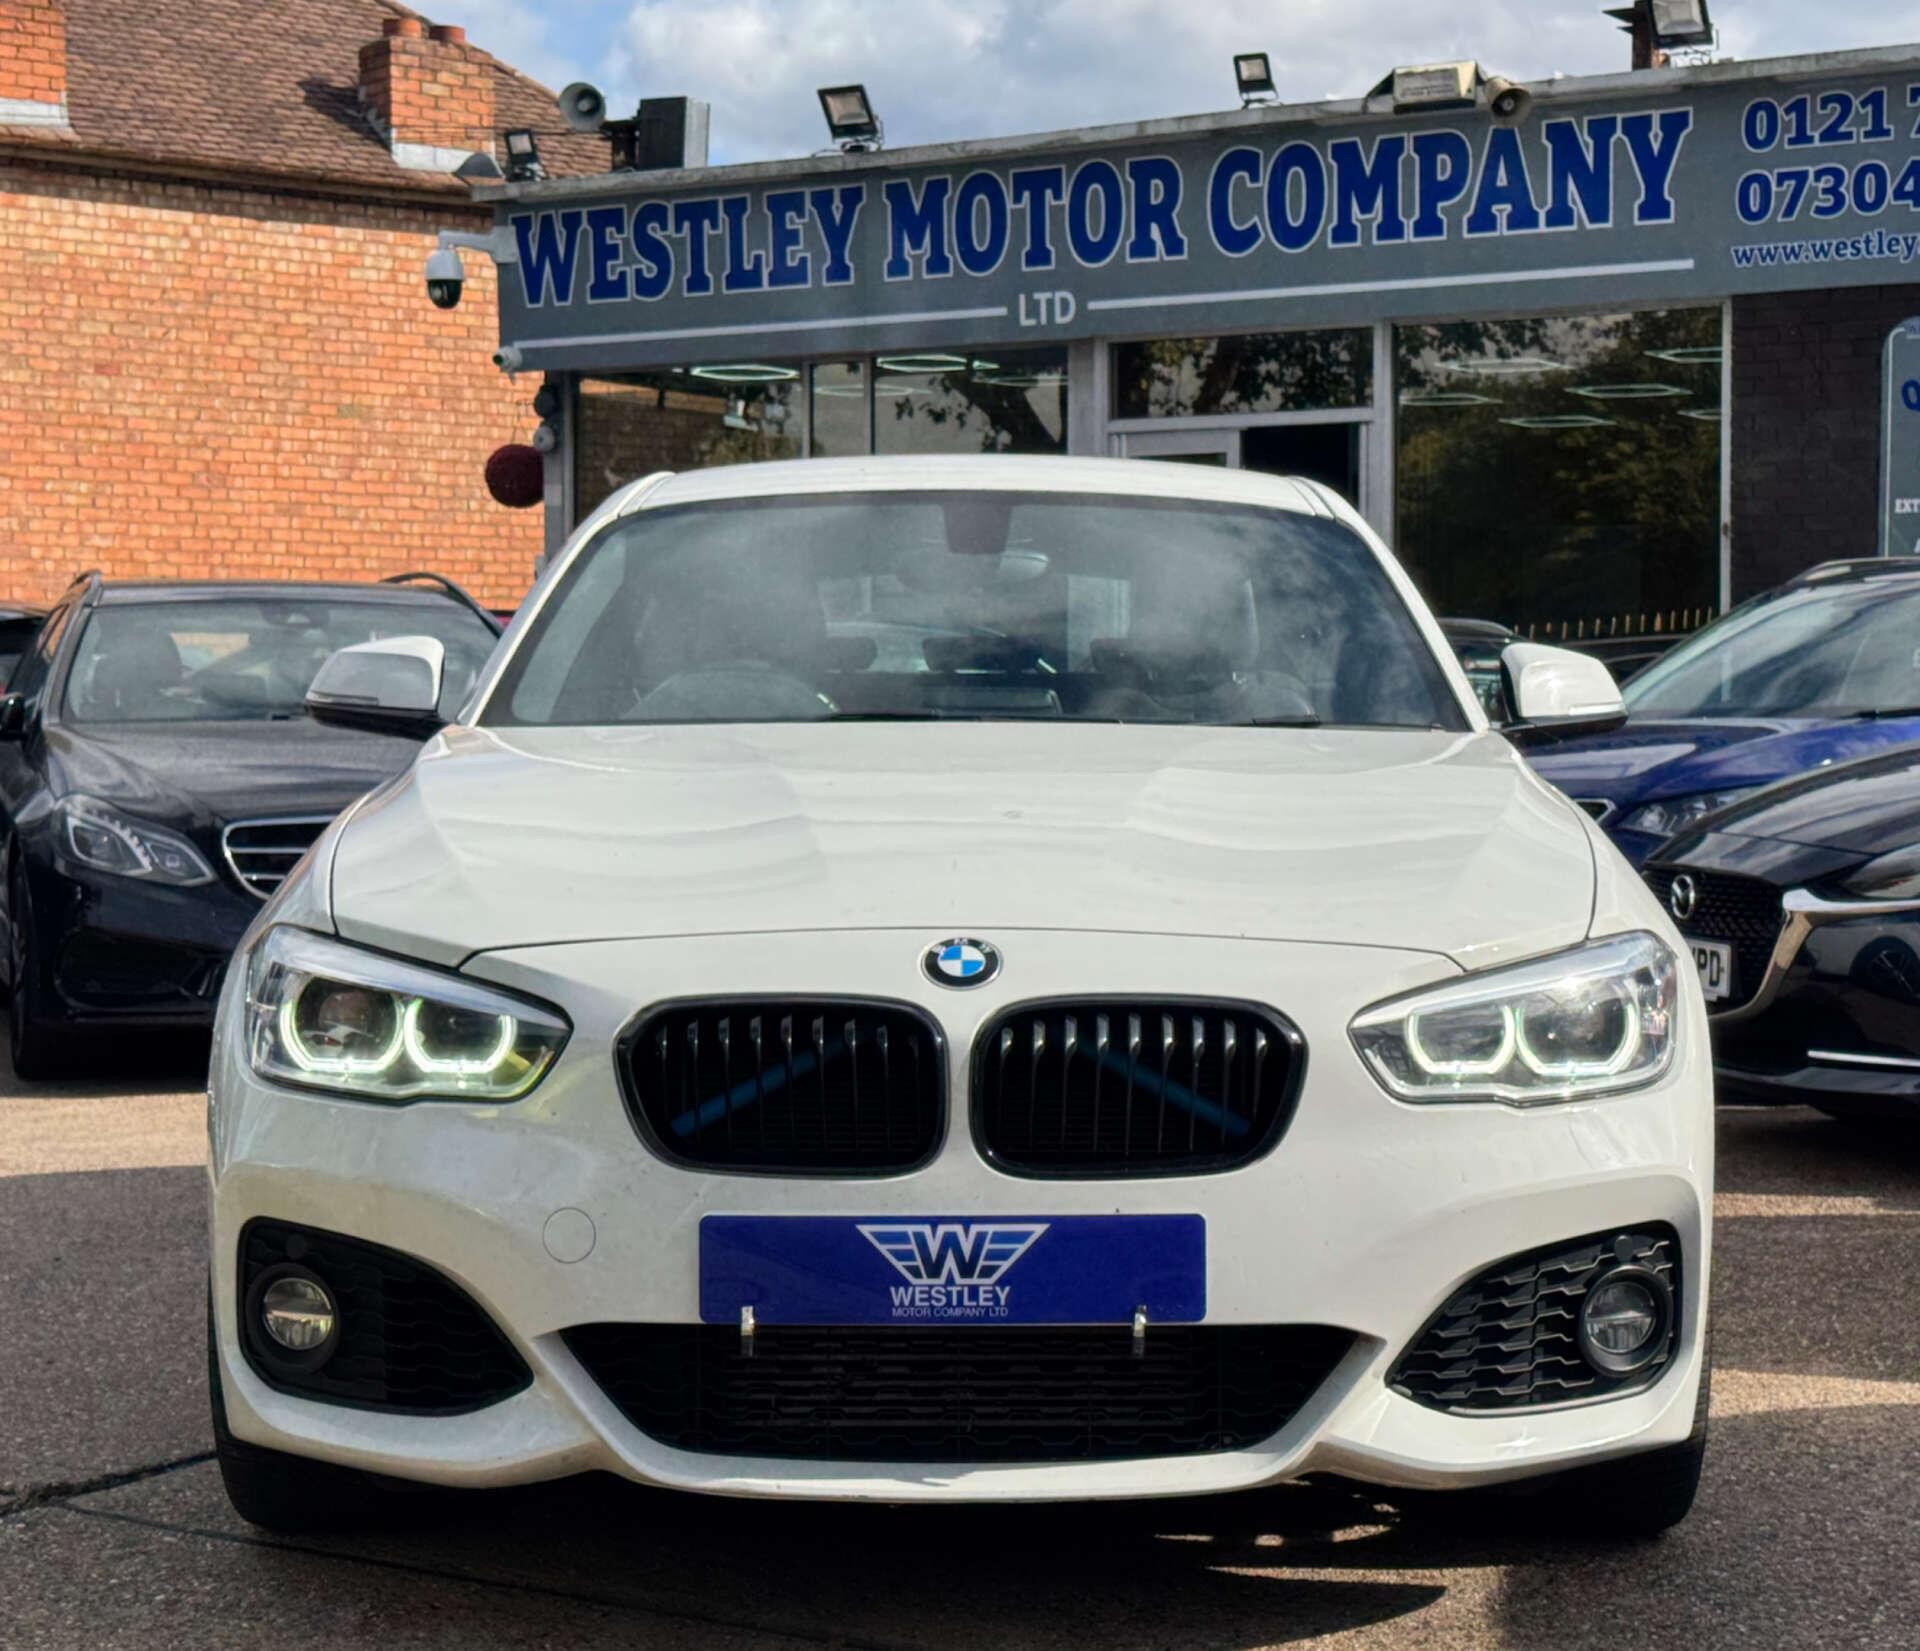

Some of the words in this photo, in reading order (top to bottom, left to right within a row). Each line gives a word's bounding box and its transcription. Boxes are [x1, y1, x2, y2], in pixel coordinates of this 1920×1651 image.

[1741, 87, 1895, 153] 0121
[511, 182, 866, 308] WESTLEY
[883, 156, 1188, 283] MOTOR
[1207, 106, 1693, 258] COMPANY
[1735, 157, 1920, 225] 07304
[1731, 228, 1920, 268] www.westley
[1019, 290, 1076, 326] LTD
[1692, 946, 1720, 987] PD
[890, 1285, 1011, 1306] WESTLEY
[892, 1307, 931, 1317] MOTOR
[933, 1307, 986, 1317] COMPANY
[989, 1307, 1009, 1317] LTD
